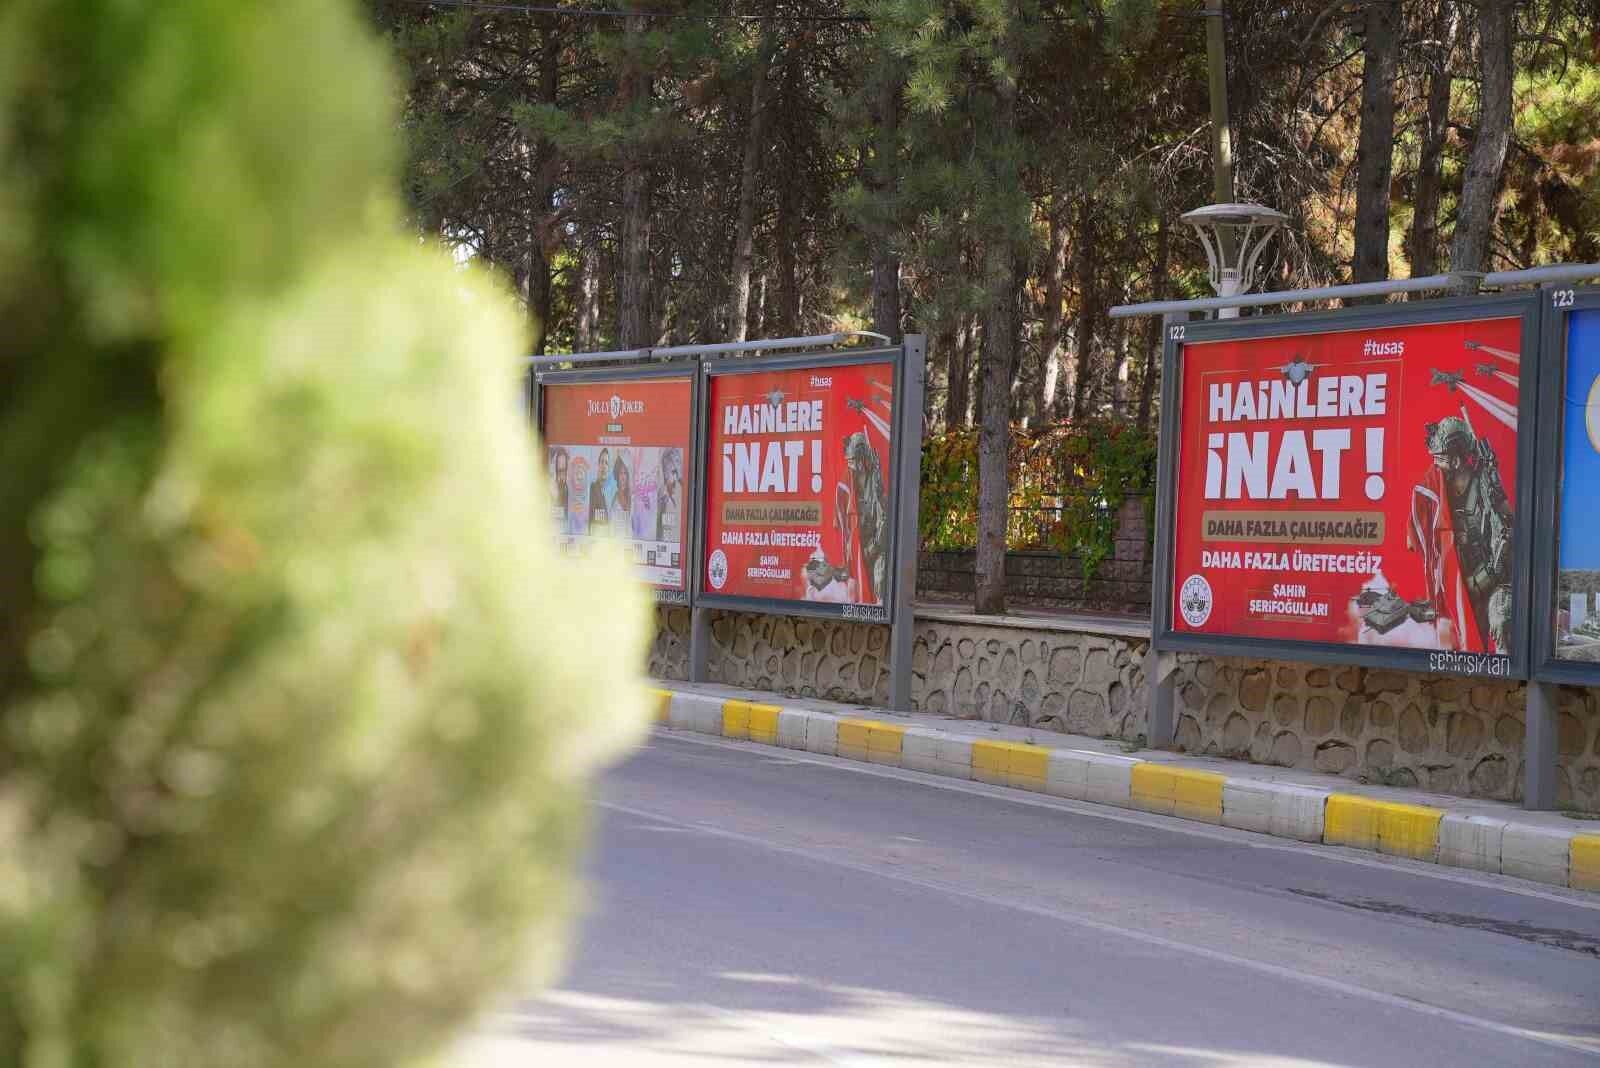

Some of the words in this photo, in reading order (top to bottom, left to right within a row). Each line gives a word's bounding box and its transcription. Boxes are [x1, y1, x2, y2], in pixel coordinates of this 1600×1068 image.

[1552, 289, 1575, 308] 123
[1169, 325, 1185, 340] 122
[1363, 339, 1404, 357] #tusaş
[1207, 519, 1243, 537] DAHA
[1246, 520, 1288, 537] FAZLA
[1290, 517, 1378, 540] ÇALIŞACAĞIZ
[721, 531, 744, 545] DAHA
[744, 532, 770, 546] FAZLA
[1202, 551, 1242, 569] DAHA
[1244, 552, 1290, 570] FAZLA
[1292, 549, 1383, 574] ÜRETECEĞİZ
